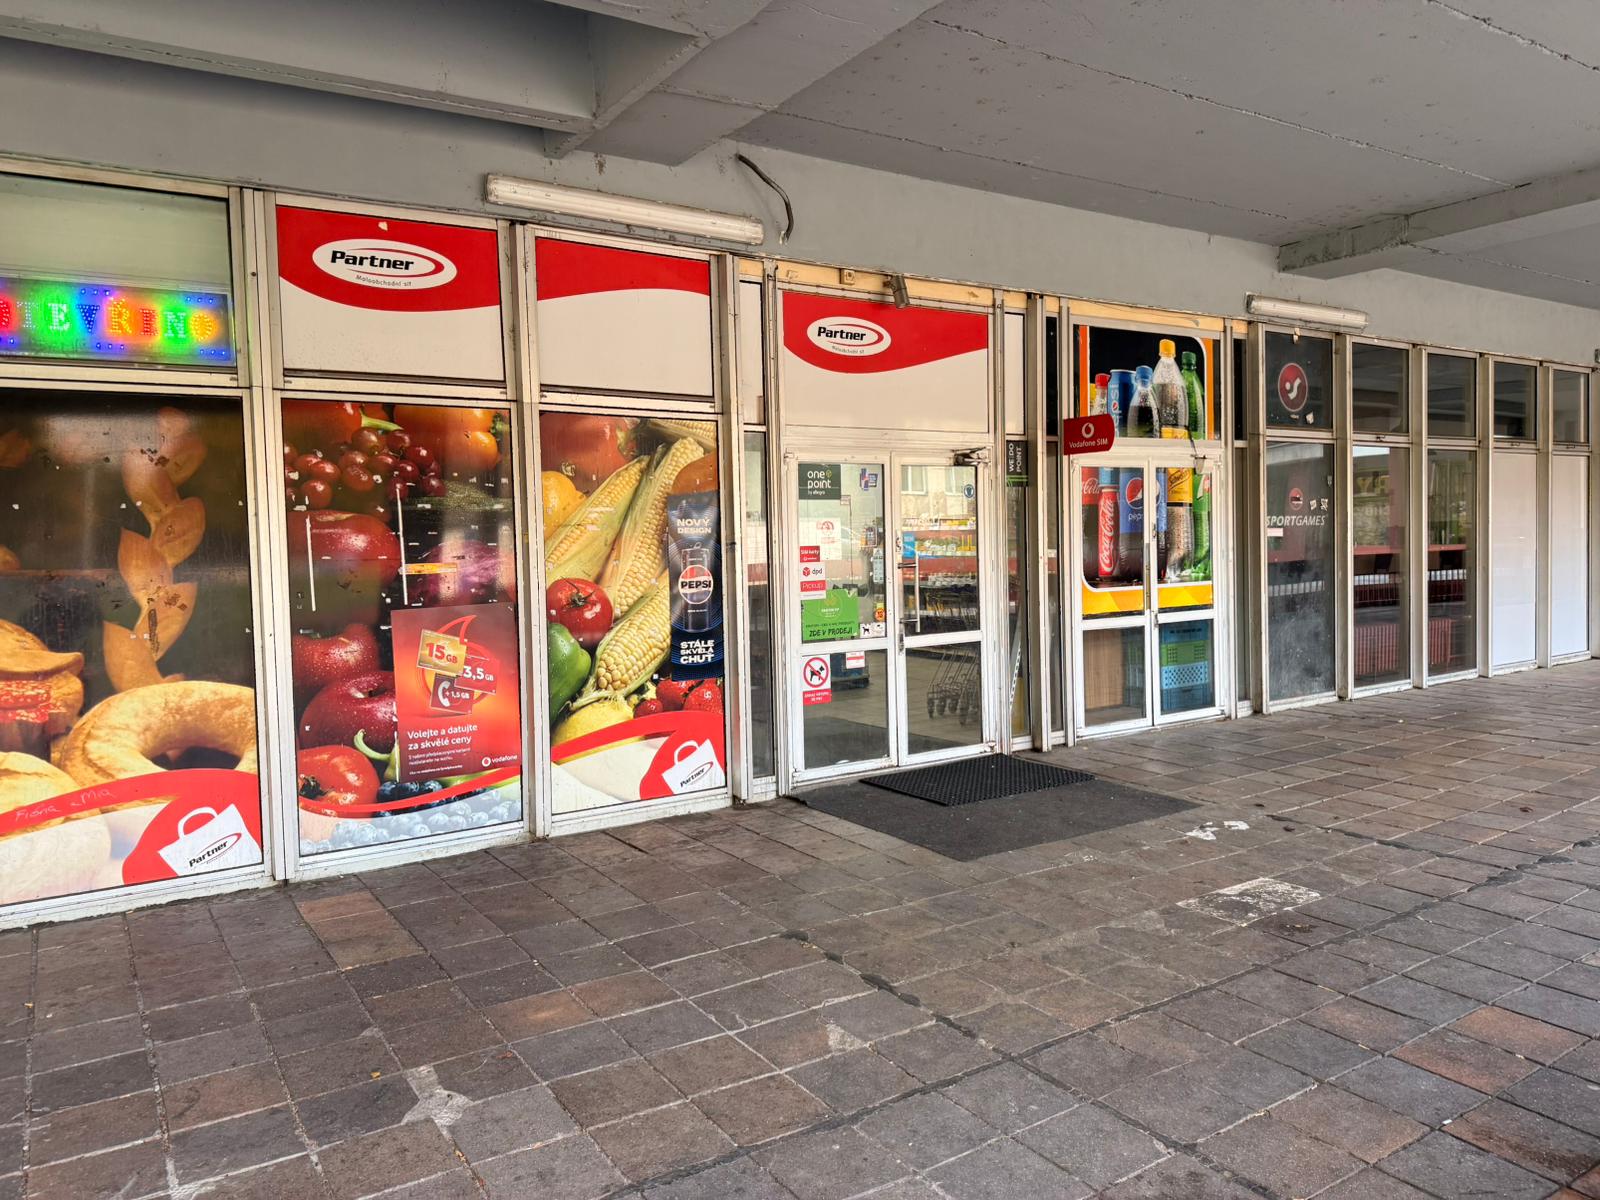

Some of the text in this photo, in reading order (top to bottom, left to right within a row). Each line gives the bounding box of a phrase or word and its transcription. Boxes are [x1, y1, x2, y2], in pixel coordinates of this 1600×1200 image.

[330, 250, 414, 271] Partner
[817, 326, 866, 341] Partner
[1069, 437, 1109, 448] Vodafone SIM
[807, 470, 825, 479] one
[807, 479, 832, 489] point
[676, 516, 710, 527] NOVÝ
[1265, 515, 1326, 527] SPORTGAMES
[812, 568, 823, 576] dpd
[680, 580, 712, 589] PEPSI
[809, 629, 821, 637] ZDE
[680, 639, 715, 649] STÁLE
[426, 643, 458, 664] 15 GB
[463, 665, 494, 682] 3,5 GB
[461, 691, 470, 699] GB
[407, 729, 438, 739] Volejte
[447, 723, 478, 734] datujte
[408, 735, 472, 750] za skvělé ceny
[491, 754, 518, 764] vodafone
[680, 767, 705, 788] Partner
[188, 841, 228, 867] Partner
